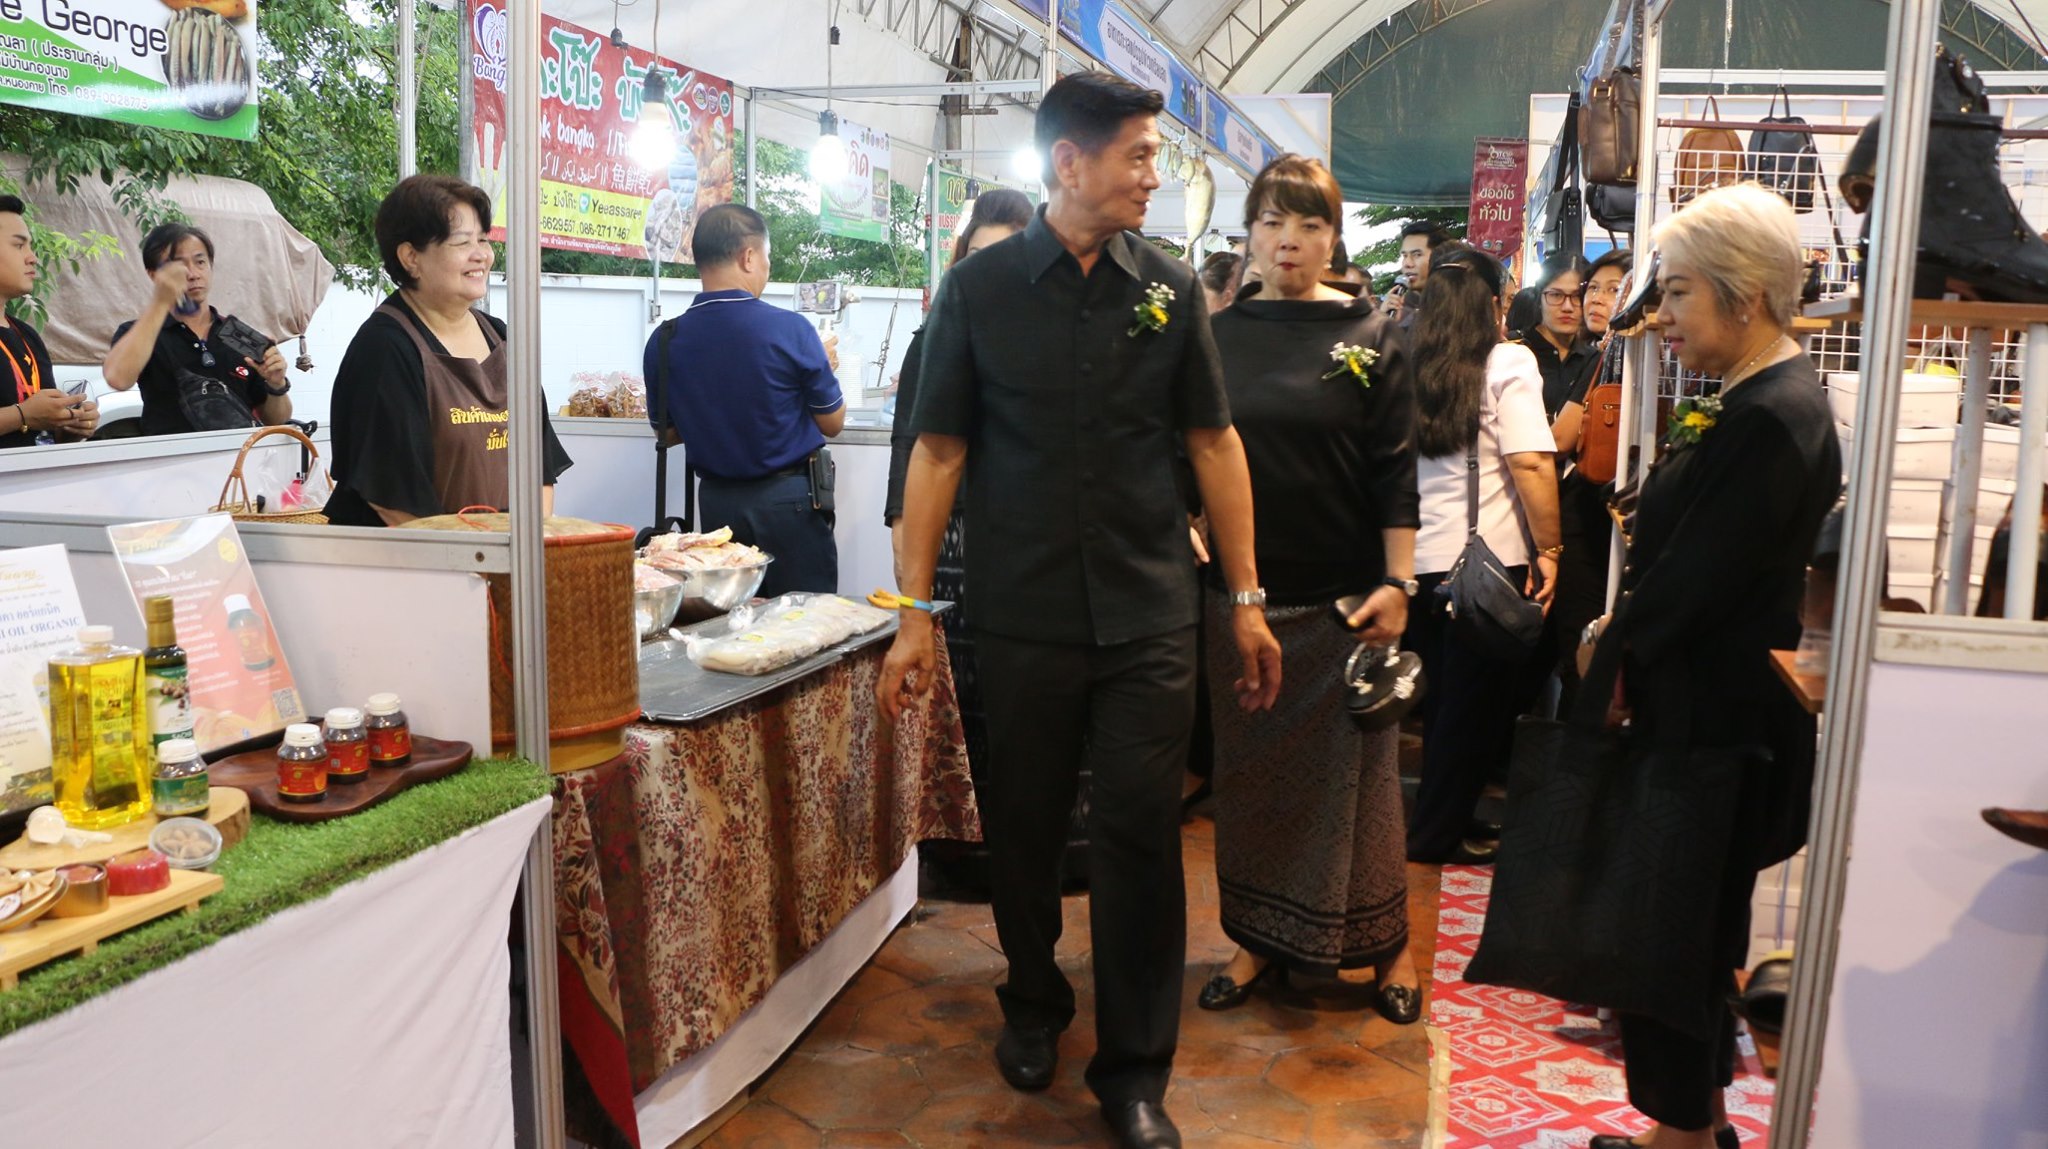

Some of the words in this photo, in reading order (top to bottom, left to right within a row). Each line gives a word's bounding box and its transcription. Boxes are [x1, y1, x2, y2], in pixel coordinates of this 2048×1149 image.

[41, 0, 168, 58] George
[0, 51, 69, 79] ม่บ้านกองนาง
[42, 40, 109, 72] ประธานกลุ่ม
[557, 113, 595, 155] bangko
[1479, 182, 1517, 200] ของใช้
[1479, 202, 1512, 222] ทั่วไป
[29, 615, 81, 634] ORGANIC
